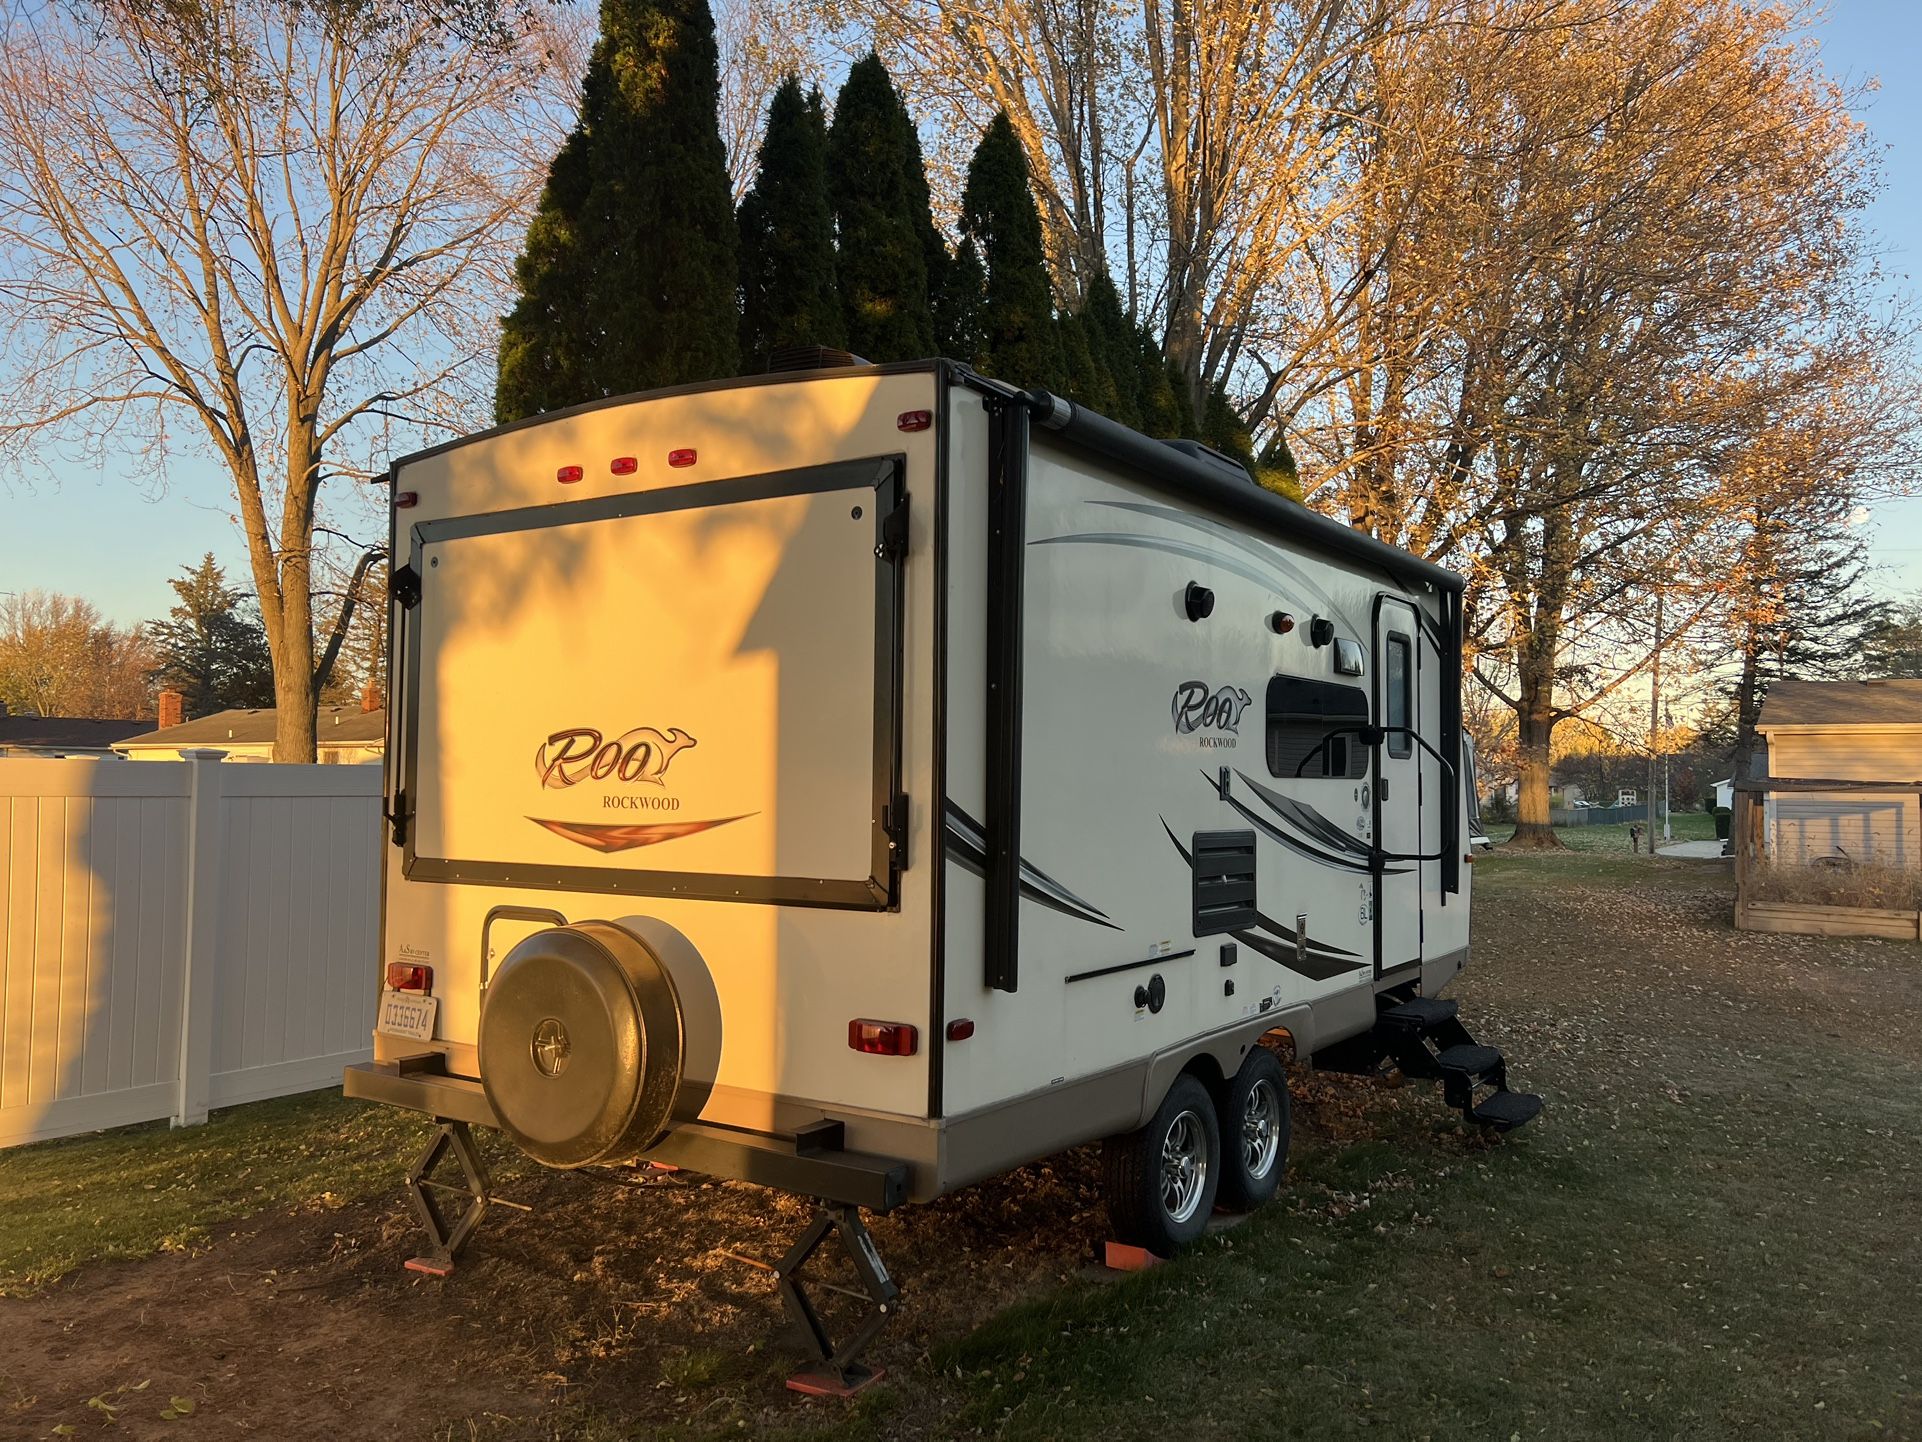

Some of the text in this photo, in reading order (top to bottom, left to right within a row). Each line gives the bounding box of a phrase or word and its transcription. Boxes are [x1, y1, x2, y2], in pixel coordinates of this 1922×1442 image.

[1176, 680, 1233, 735] Roo
[542, 728, 652, 790] Roo
[1199, 736, 1237, 749] ROCKWOOD
[602, 795, 680, 811] ROCKWOOD
